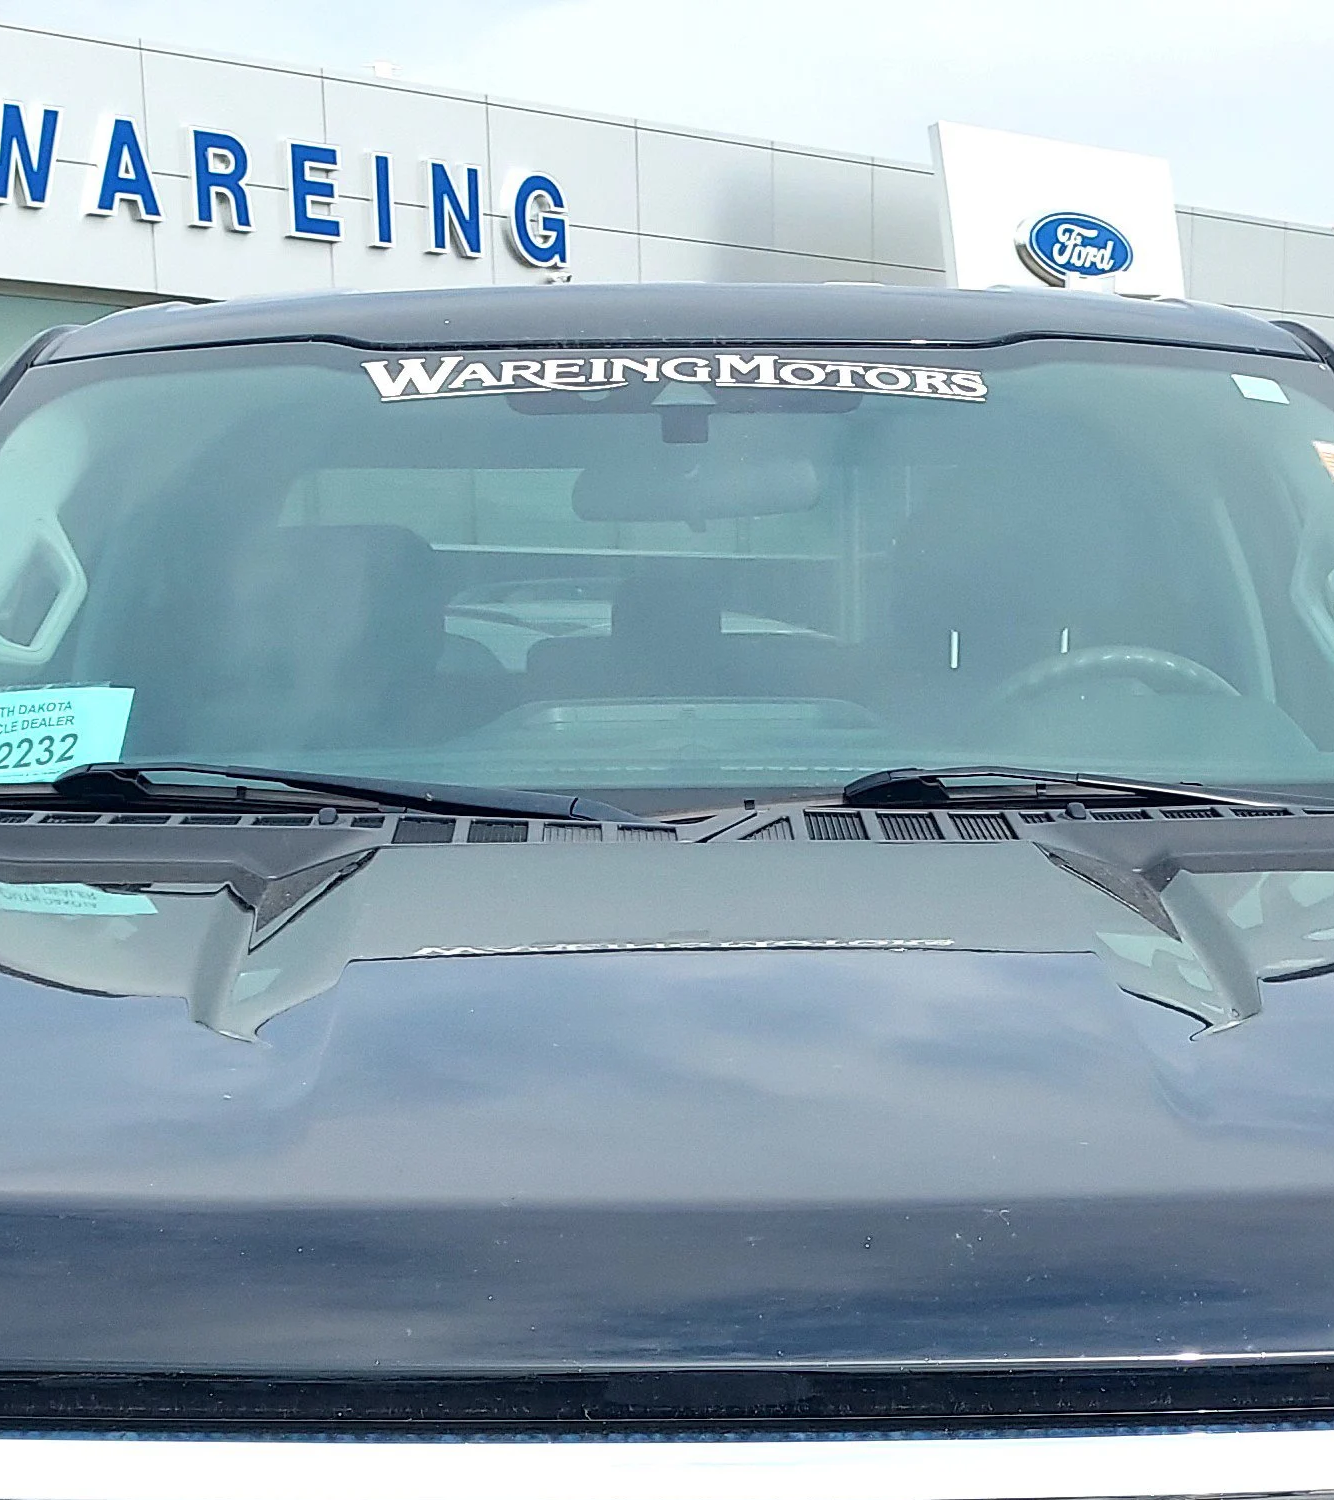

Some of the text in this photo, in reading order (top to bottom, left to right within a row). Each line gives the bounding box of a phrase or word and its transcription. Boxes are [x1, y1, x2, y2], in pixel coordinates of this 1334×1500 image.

[1052, 223, 1119, 271] Ford
[18, 701, 72, 715] DAKOTA
[21, 715, 75, 730] DEALER
